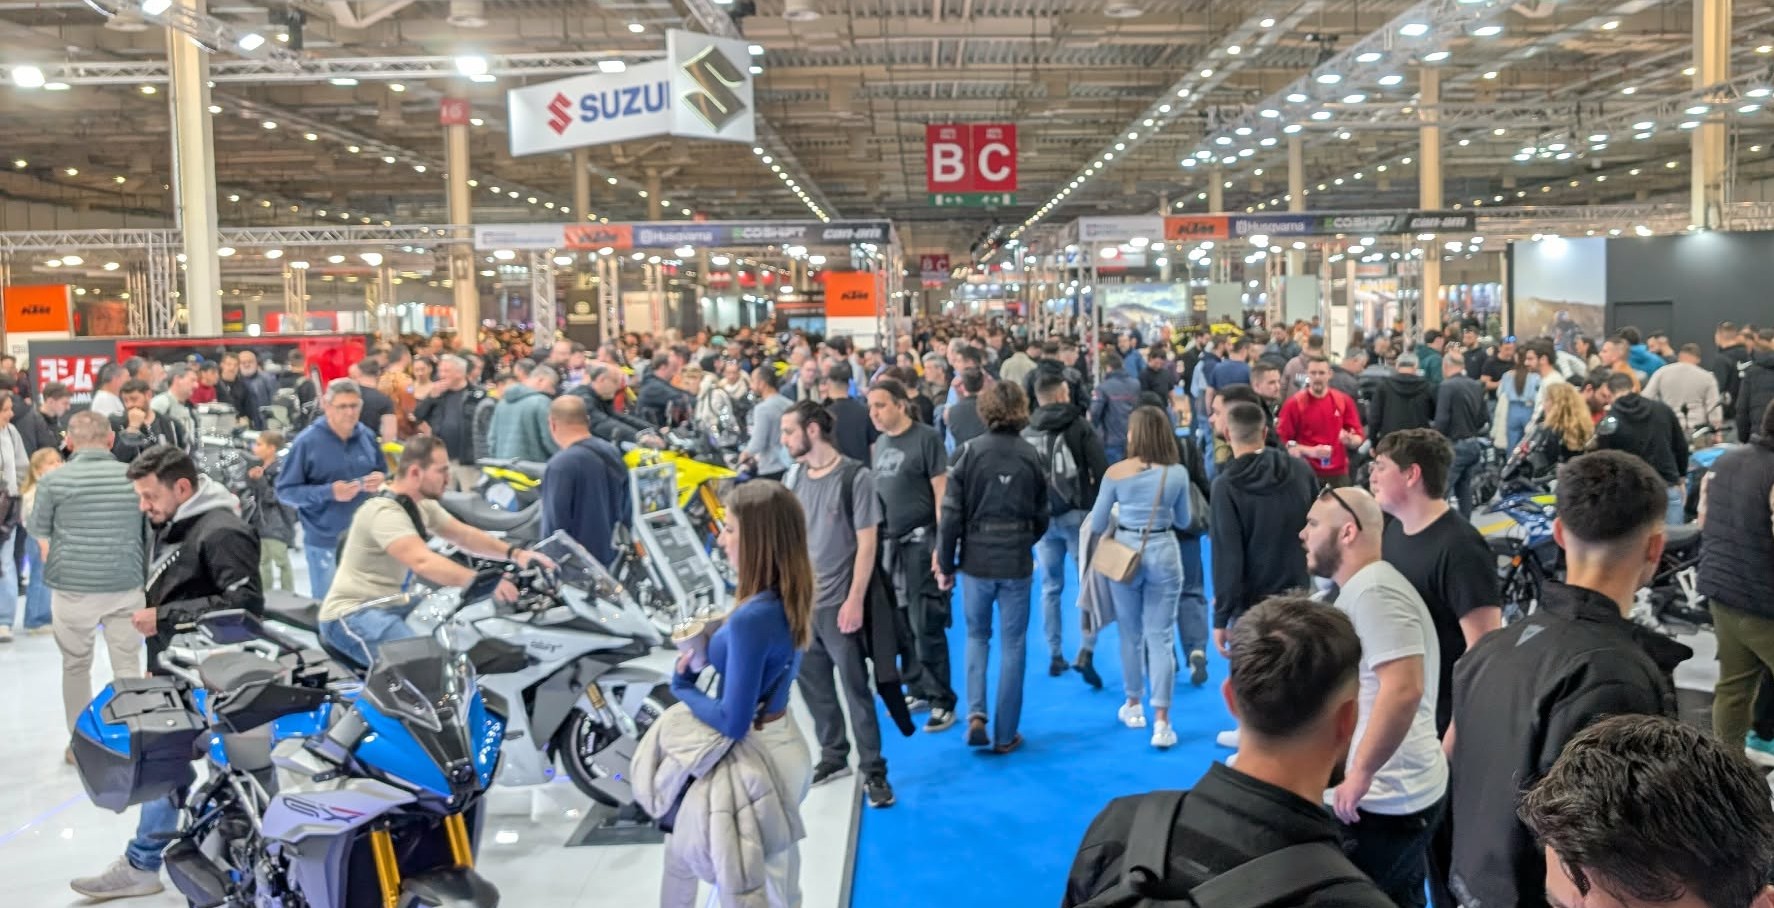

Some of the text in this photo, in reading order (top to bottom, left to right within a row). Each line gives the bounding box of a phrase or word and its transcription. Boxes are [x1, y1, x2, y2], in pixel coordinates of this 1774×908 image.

[932, 142, 1011, 182] B C
[1248, 220, 1305, 234] Husqvarna
[654, 230, 713, 243] Husqvarna
[923, 259, 948, 271] B C
